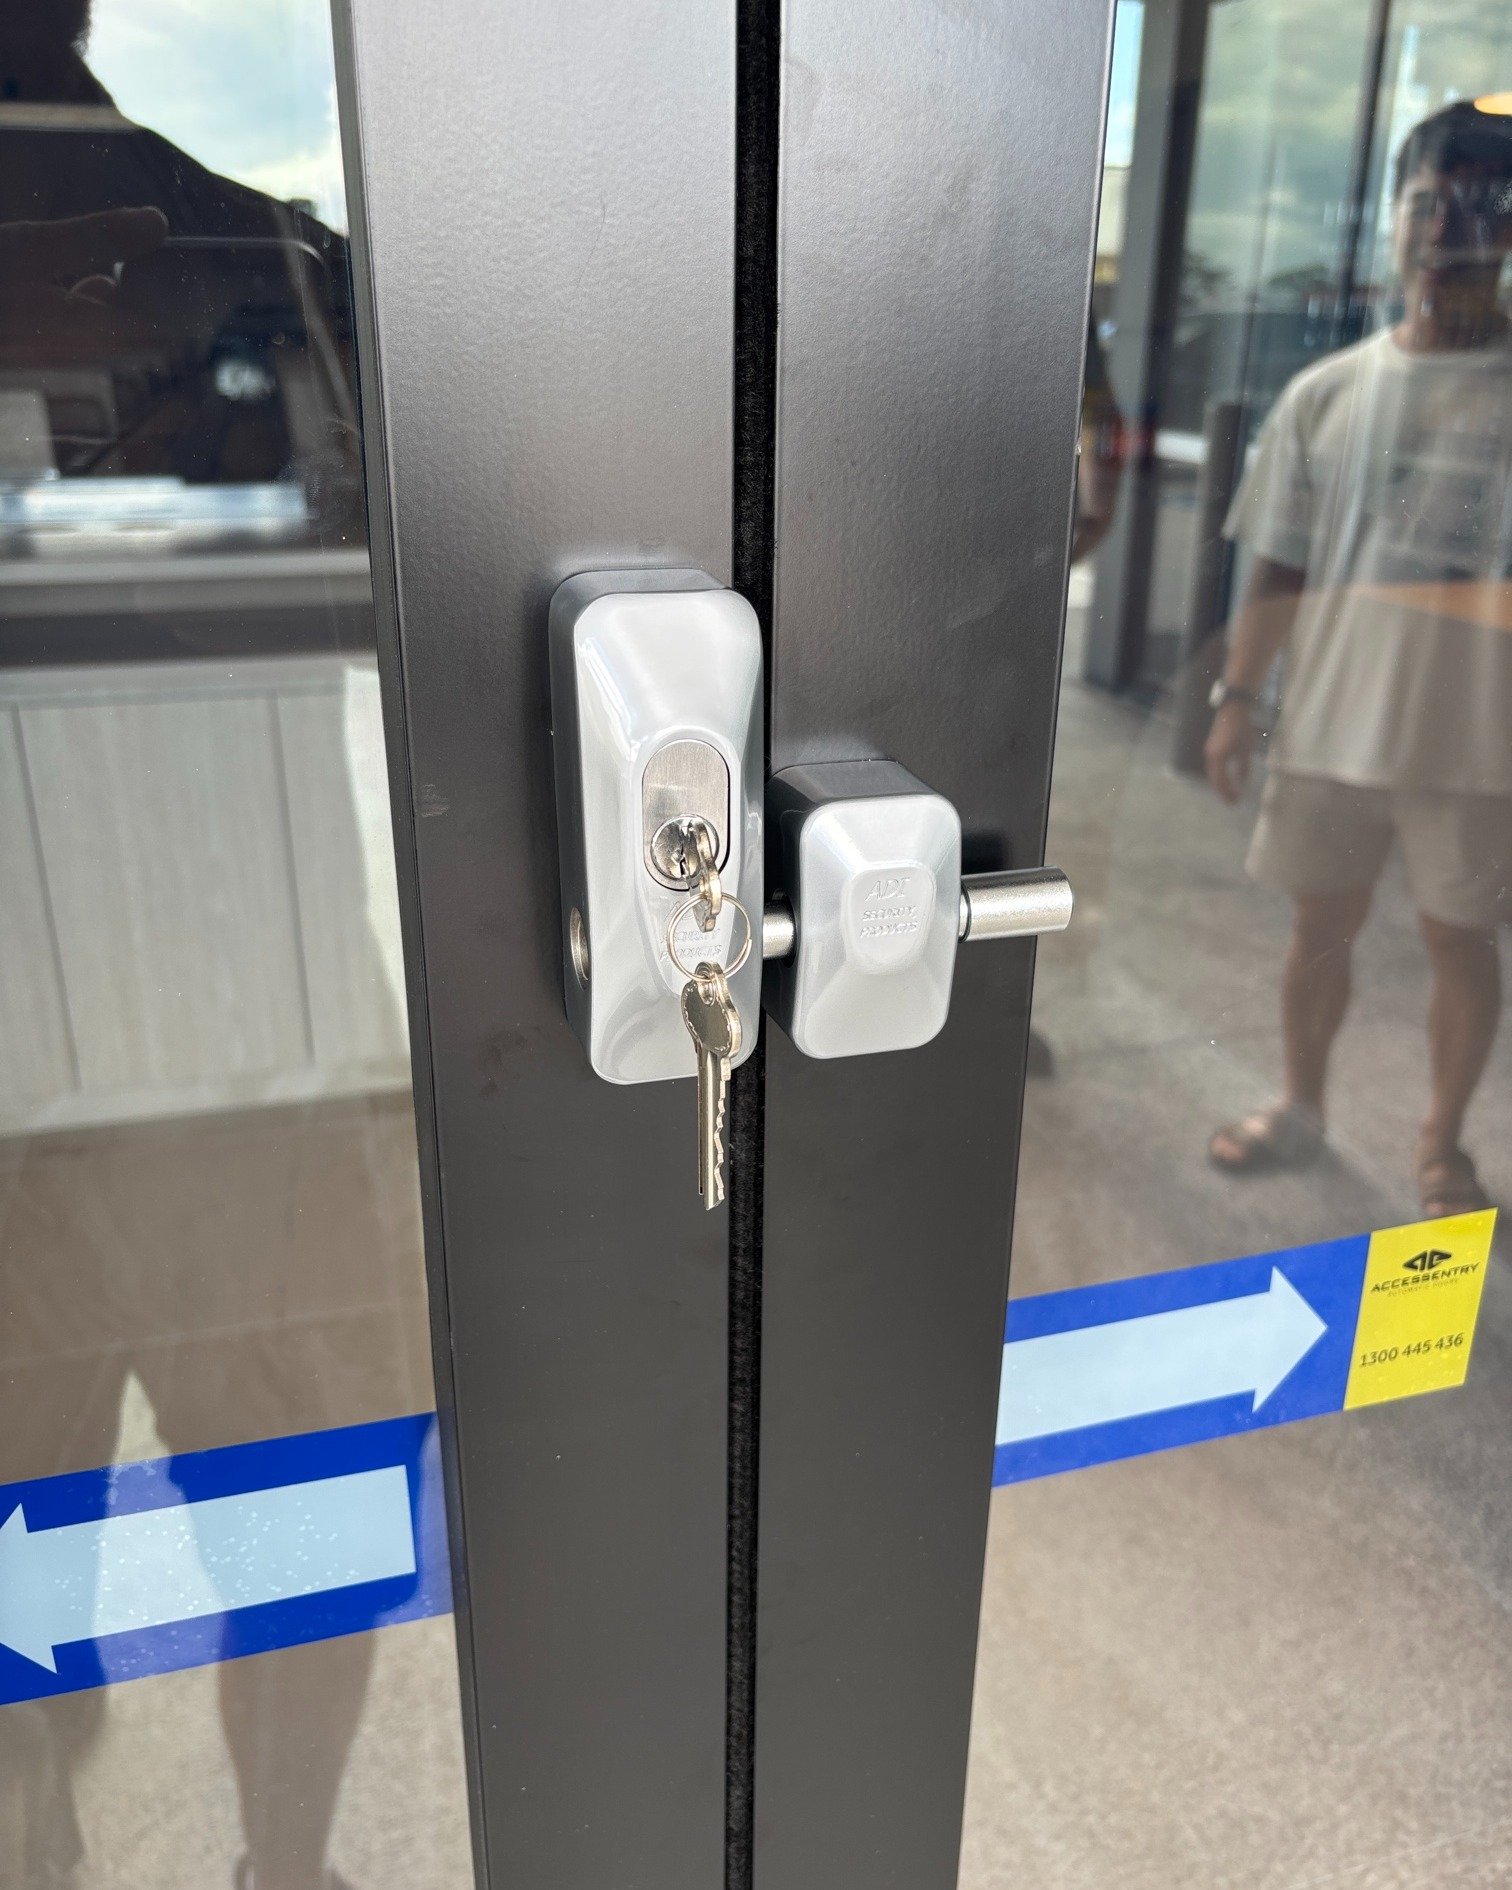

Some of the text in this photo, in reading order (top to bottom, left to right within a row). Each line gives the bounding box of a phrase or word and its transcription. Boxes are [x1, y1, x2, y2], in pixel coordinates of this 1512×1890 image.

[1370, 1262, 1481, 1294] ACCESSENTRY
[1359, 1332, 1464, 1367] 1300 445 436
